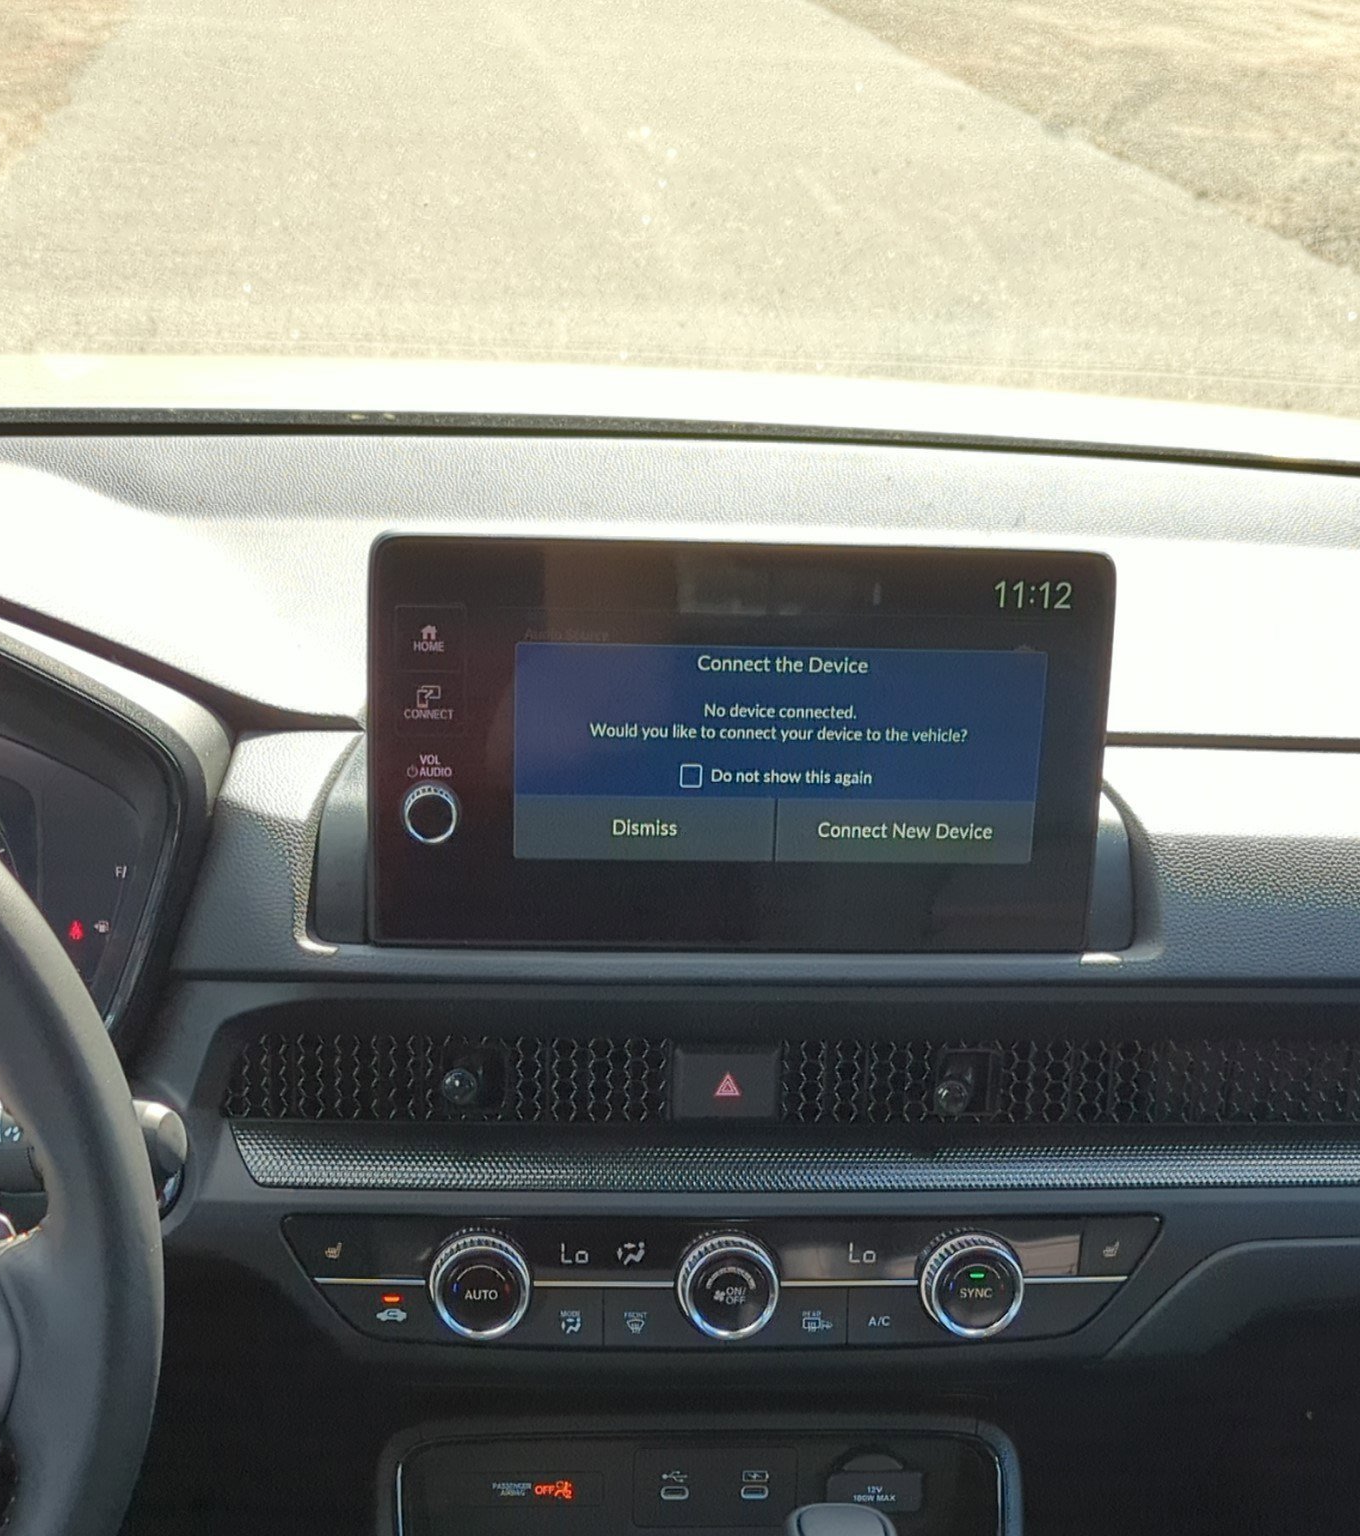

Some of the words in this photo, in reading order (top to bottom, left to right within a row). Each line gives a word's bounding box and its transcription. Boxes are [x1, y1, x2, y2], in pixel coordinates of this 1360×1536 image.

[993, 581, 1072, 610] 11:12
[413, 641, 444, 652] HOME
[697, 655, 771, 673] Connect
[776, 656, 803, 673] the
[809, 657, 868, 673] Device
[404, 709, 454, 720] CONNECT
[704, 704, 725, 718] No
[729, 704, 775, 719] device
[779, 705, 857, 720] connected.
[590, 723, 638, 738] Would
[642, 726, 668, 741] you
[672, 723, 697, 739] like
[700, 725, 716, 739] to
[720, 726, 776, 740] connect
[780, 729, 813, 743] your
[817, 726, 862, 741] device
[866, 728, 881, 741] to
[885, 728, 908, 742] the
[912, 728, 968, 743] vehicle?
[420, 754, 441, 765] VOL
[420, 766, 452, 778] AUDIO
[711, 767, 731, 784] Do
[734, 768, 758, 784] not
[762, 767, 797, 785] show
[803, 767, 830, 785] this
[834, 769, 873, 788] again
[612, 817, 677, 837] Dismiss
[818, 821, 887, 840] Connect
[892, 822, 930, 841] New
[935, 821, 993, 841] Device
[560, 1242, 589, 1264] Lo
[848, 1242, 877, 1264] Lo
[464, 1289, 499, 1301] AUTO
[959, 1287, 994, 1299] SYNC
[725, 1295, 746, 1305] OFF
[623, 1311, 647, 1319] FRONT
[867, 1316, 891, 1327] A/C
[492, 1482, 532, 1490] PASSENGER
[534, 1485, 555, 1495] OFF
[867, 1485, 883, 1494] 12V
[876, 1494, 897, 1503] MAX
